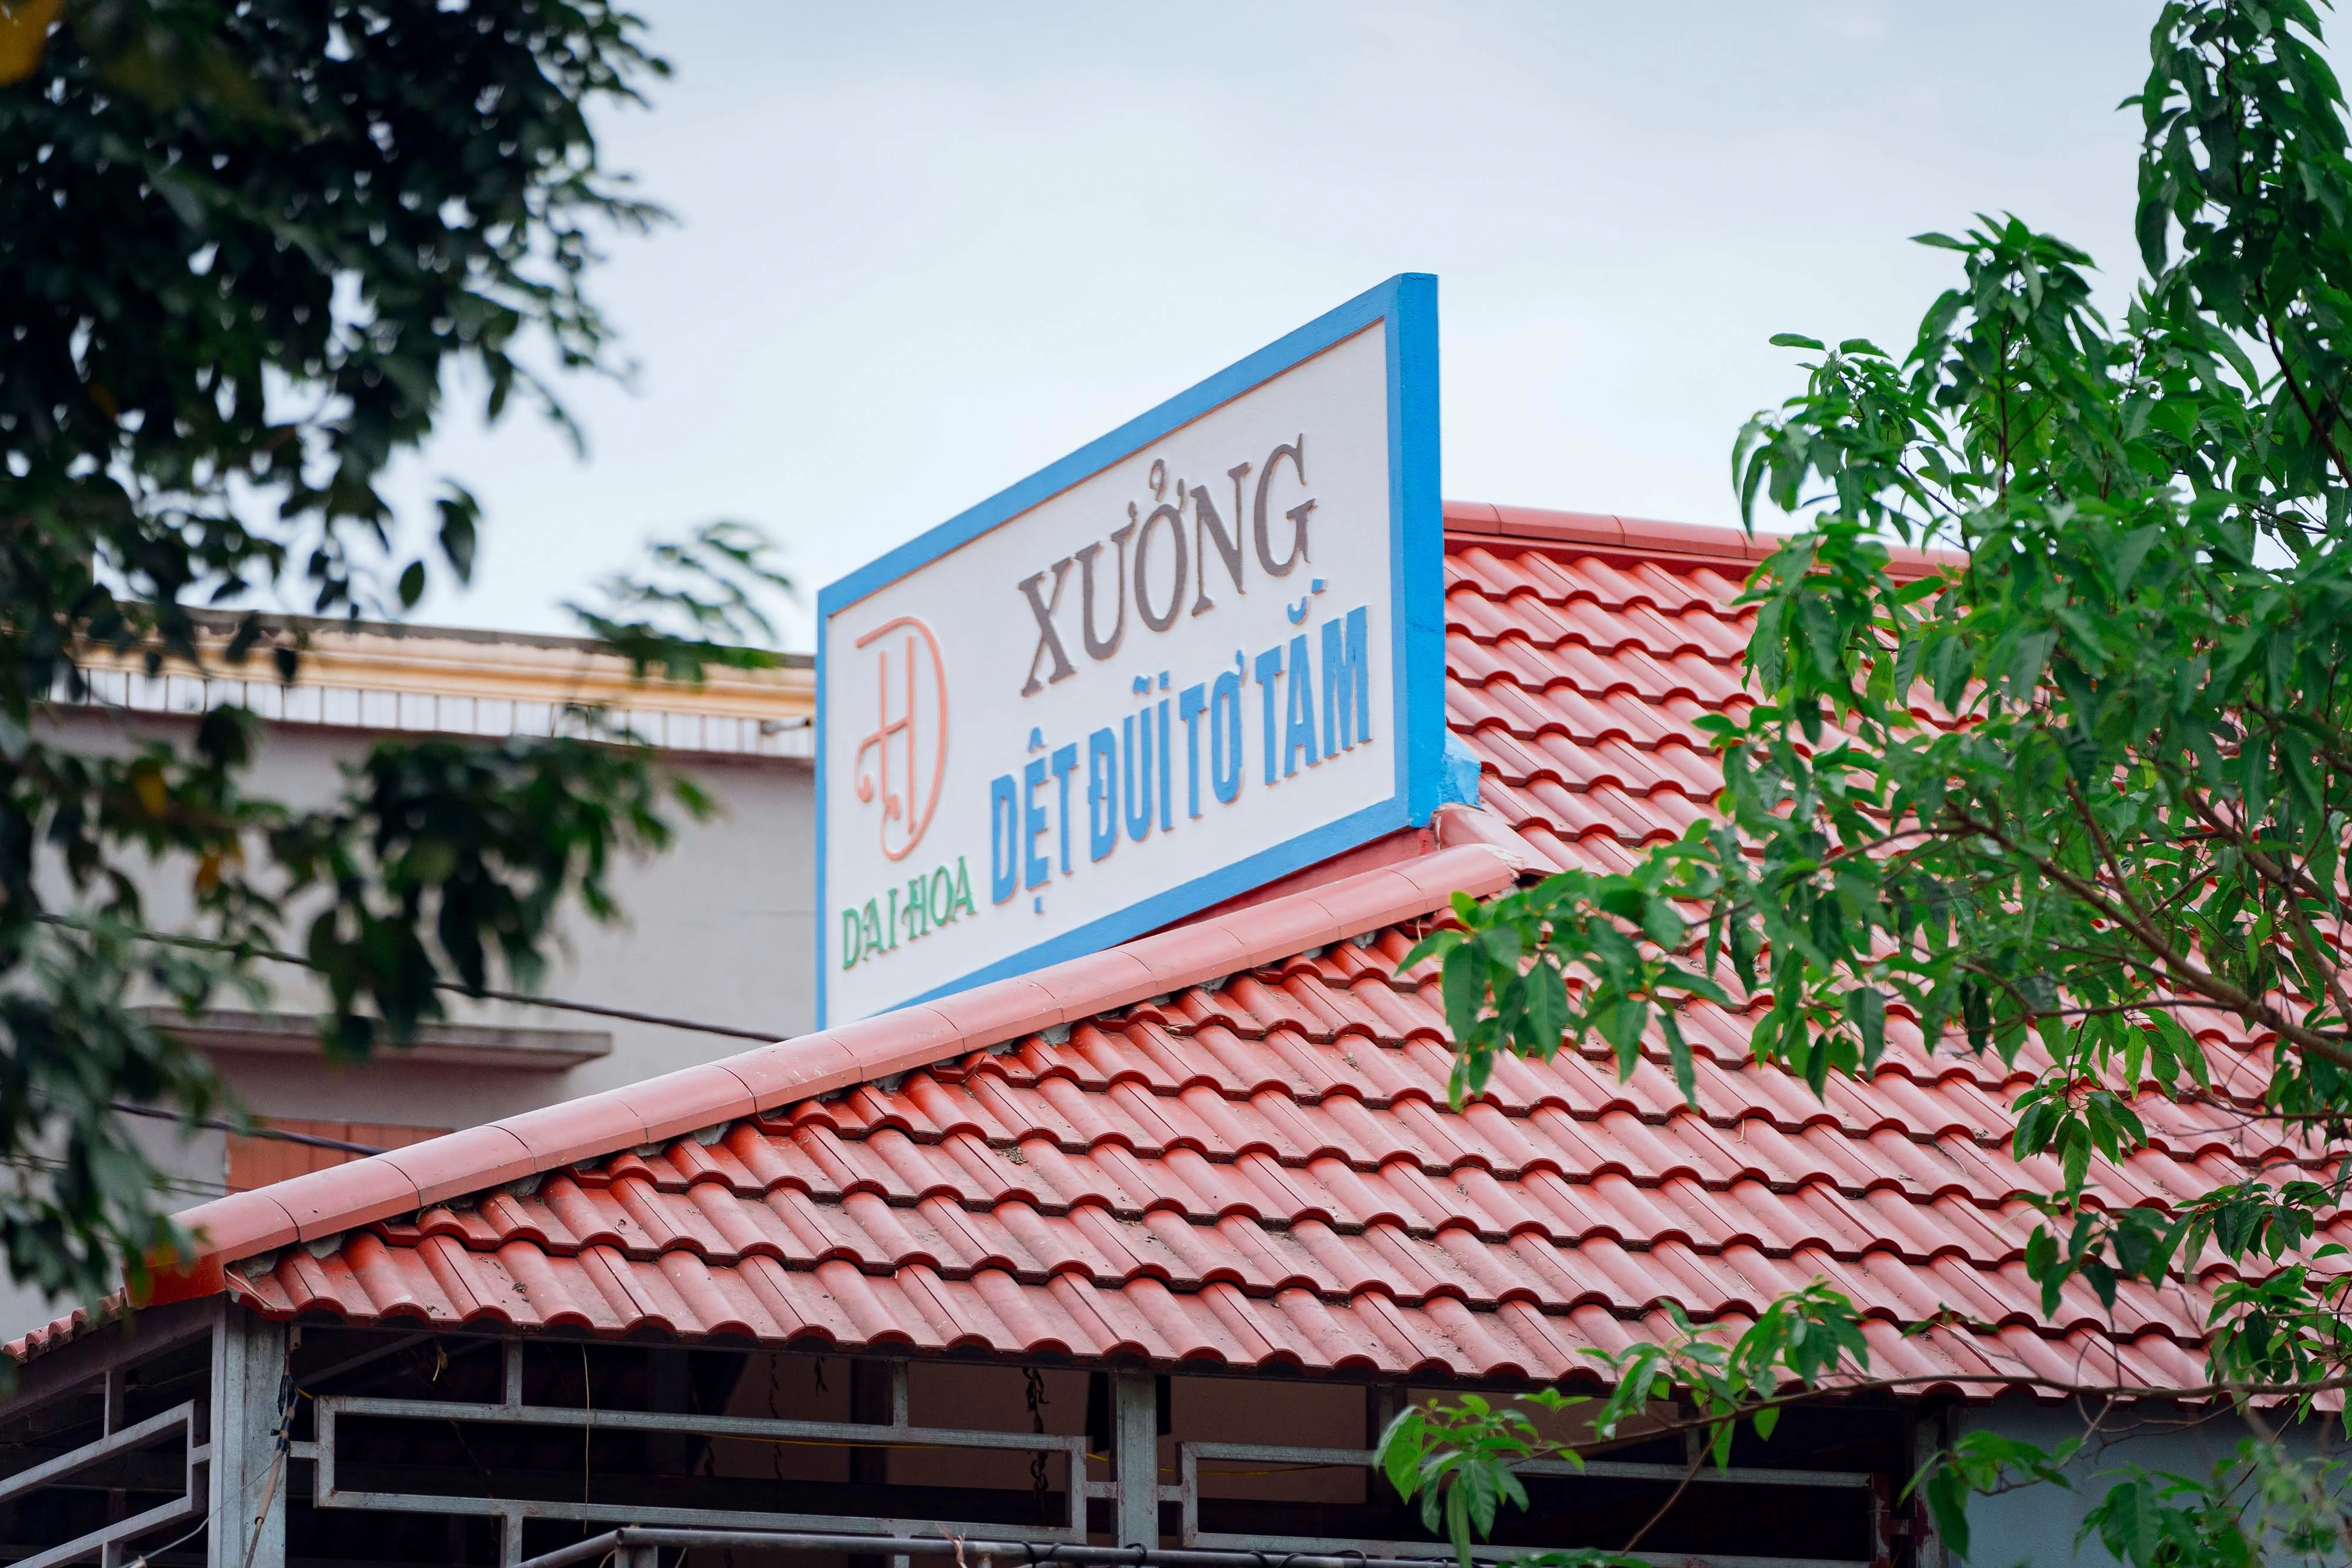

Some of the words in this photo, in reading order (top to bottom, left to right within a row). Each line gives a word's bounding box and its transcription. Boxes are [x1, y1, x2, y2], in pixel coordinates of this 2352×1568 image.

[1018, 433, 1318, 698] XƯỞNG
[901, 856, 977, 941] HOA
[991, 726, 1080, 915] DỆT
[1180, 650, 1247, 820] TƠ
